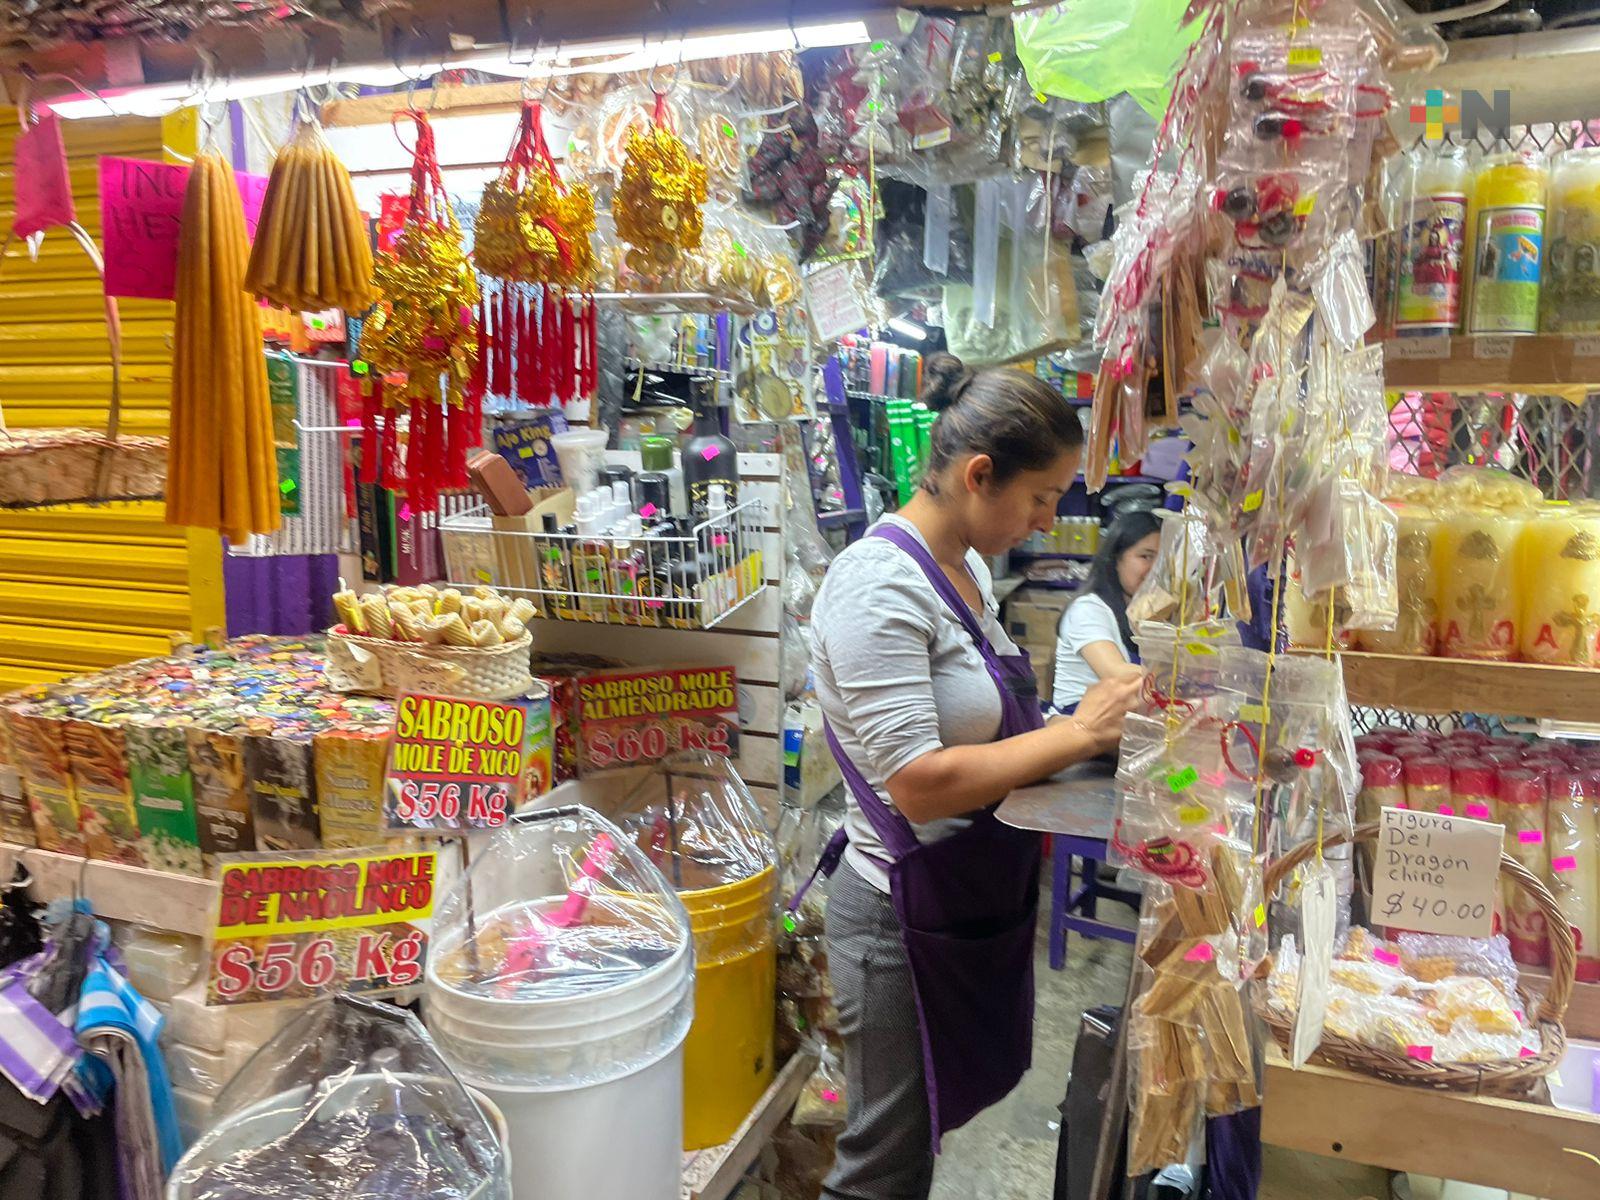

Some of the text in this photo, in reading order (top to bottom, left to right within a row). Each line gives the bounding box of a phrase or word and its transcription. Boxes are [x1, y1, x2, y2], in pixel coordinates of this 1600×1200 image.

[580, 671, 735, 701] SABROSO MOLE
[582, 688, 735, 720] ALMENDRADO
[396, 696, 524, 747] SABROSO
[393, 742, 521, 777] MOLE DE XICO
[588, 726, 668, 768] $60
[679, 721, 732, 757] Kg
[398, 779, 508, 827] $56 Kg
[1383, 810, 1453, 832] Figura
[1388, 826, 1432, 848] Del
[223, 855, 434, 896] SABROSO MOLE
[219, 880, 433, 927] DE NAOLINCO
[216, 931, 423, 996] $56 Kg
